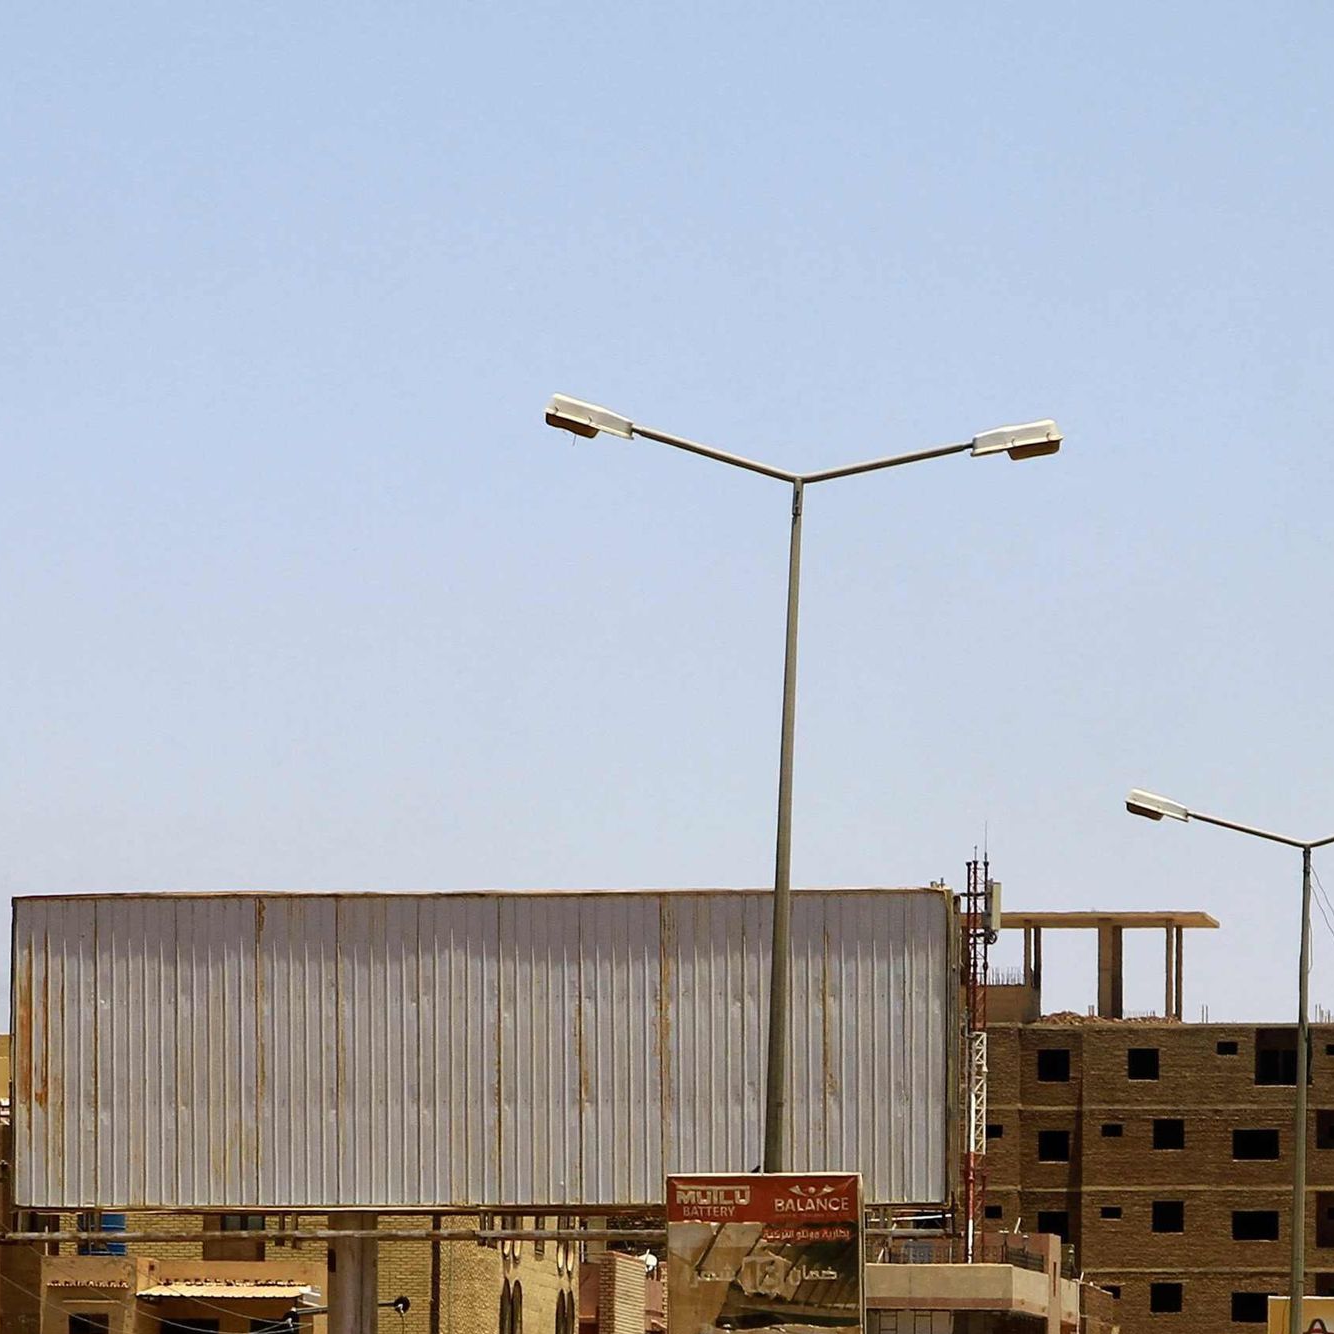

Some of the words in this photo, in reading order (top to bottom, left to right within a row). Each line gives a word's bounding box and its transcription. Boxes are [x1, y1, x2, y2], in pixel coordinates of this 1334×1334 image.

[676, 1185, 750, 1205] MUTLU
[683, 1206, 736, 1217] BATTERY
[774, 1197, 849, 1213] BALANCE
